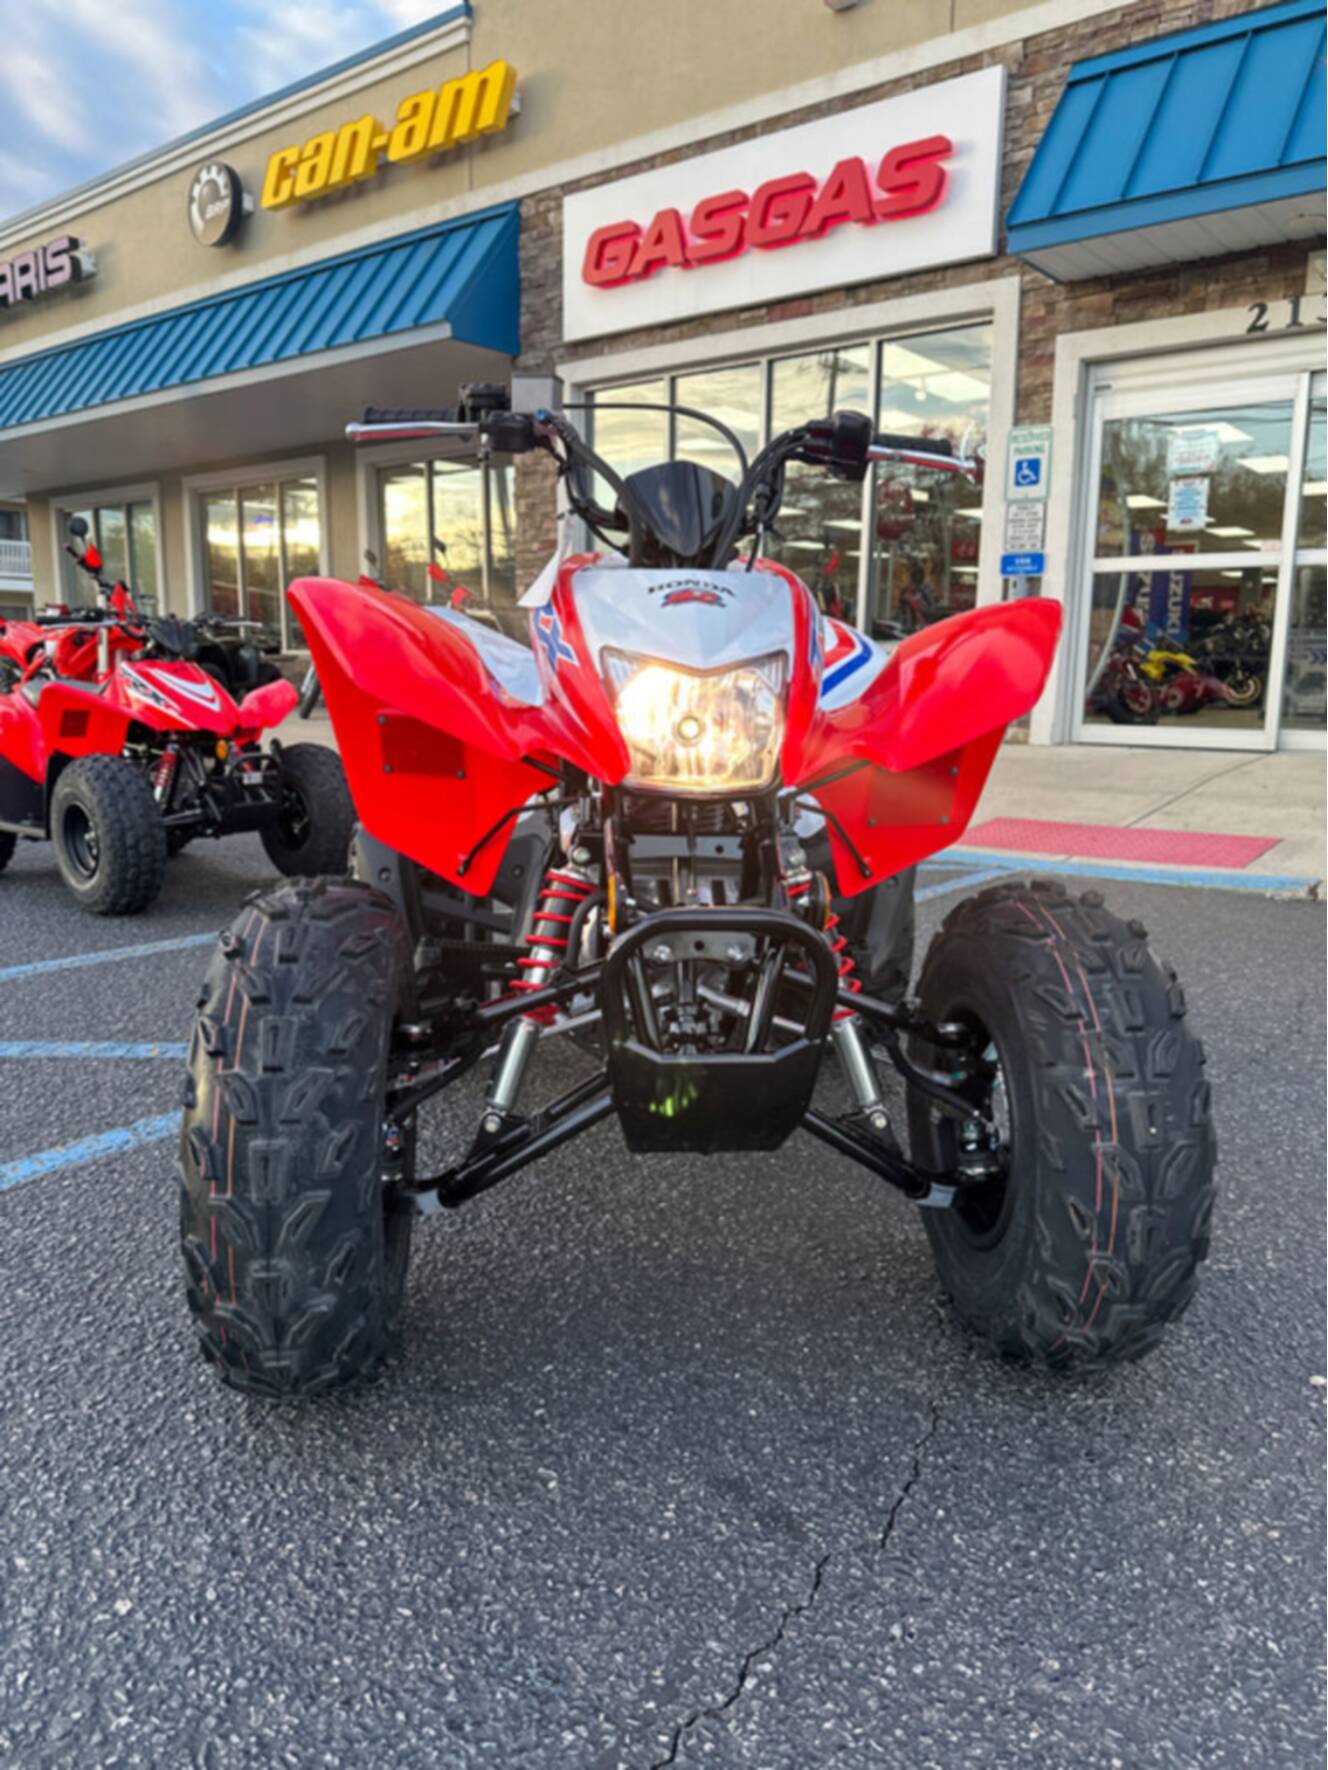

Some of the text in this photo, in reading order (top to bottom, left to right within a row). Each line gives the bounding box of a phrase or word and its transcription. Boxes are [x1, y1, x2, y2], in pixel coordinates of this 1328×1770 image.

[260, 60, 515, 211] can-am
[582, 135, 953, 287] GASGAS
[1246, 291, 1327, 334] 21
[648, 579, 736, 598] HONDA
